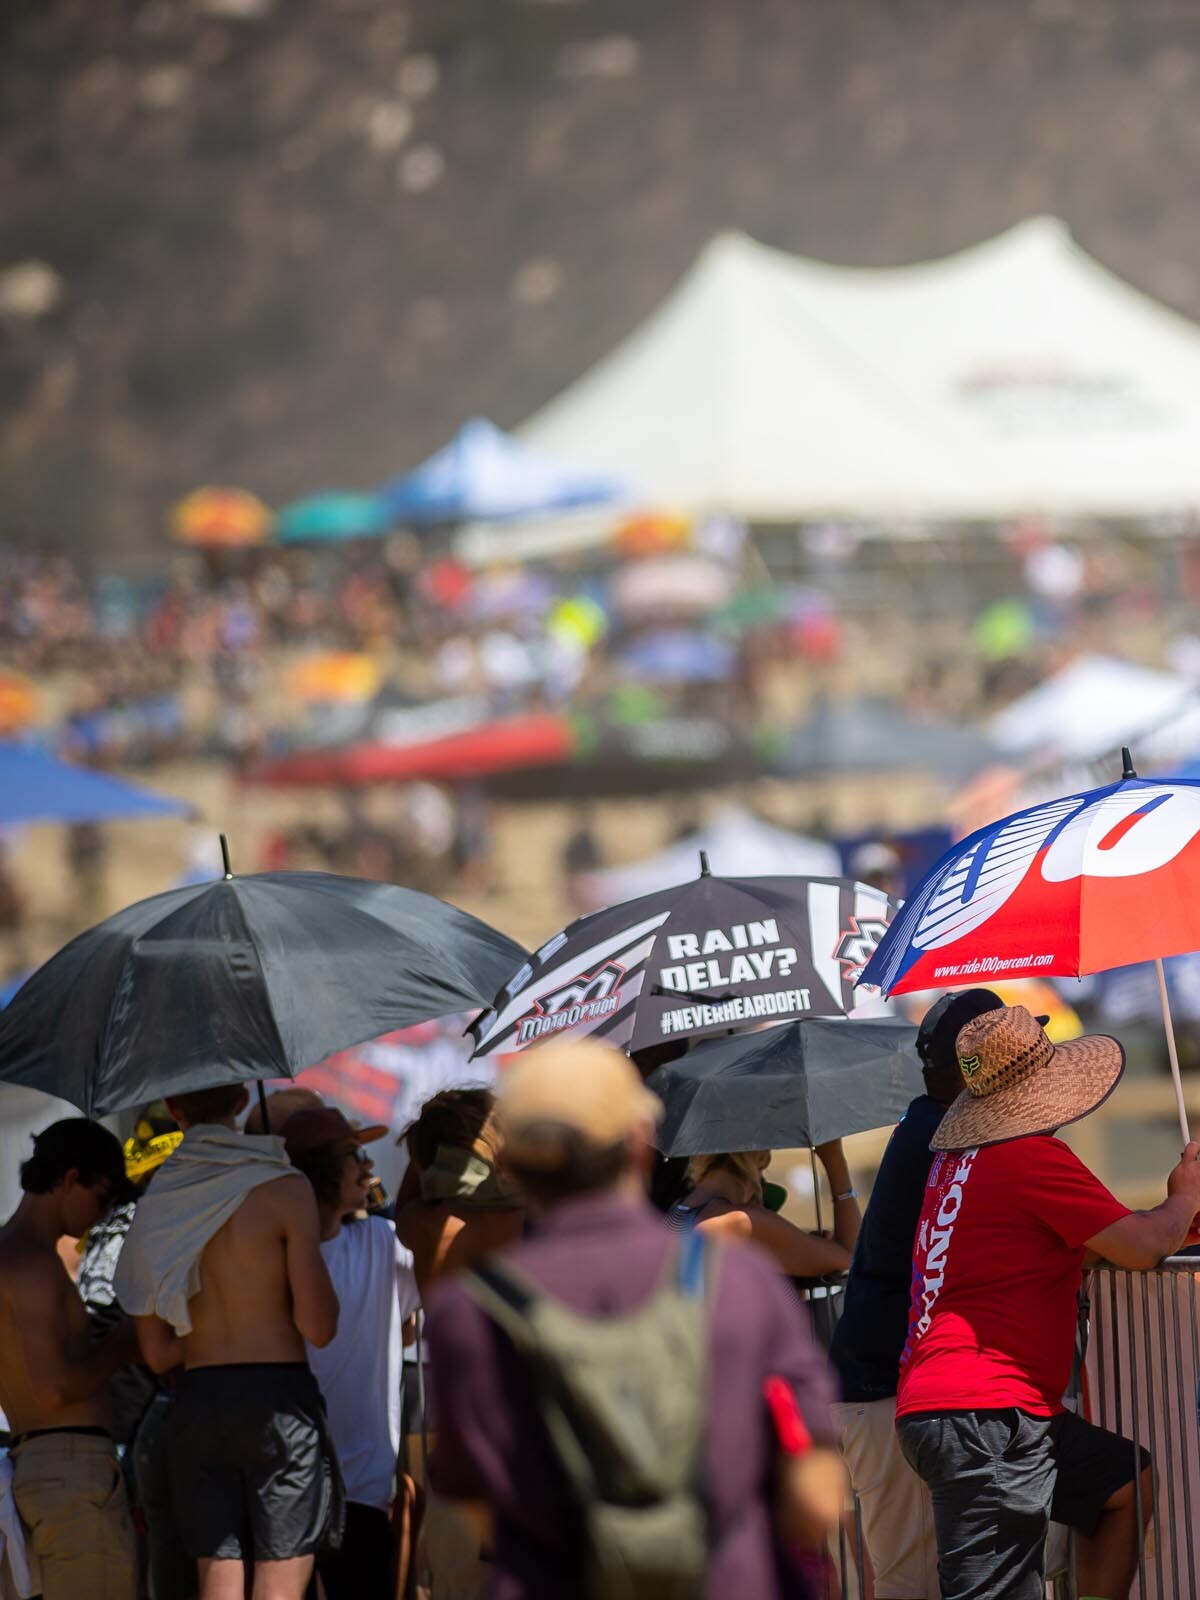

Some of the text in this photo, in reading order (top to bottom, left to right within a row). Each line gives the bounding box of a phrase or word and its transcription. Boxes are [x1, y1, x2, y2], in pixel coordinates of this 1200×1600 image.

[666, 919, 781, 961] RAIN
[659, 947, 799, 994] DELAY?
[934, 953, 1054, 978] www.ride100percent.com
[660, 988, 812, 1035] #NEVERHEARDOFIT
[917, 1147, 979, 1339] HONDA
